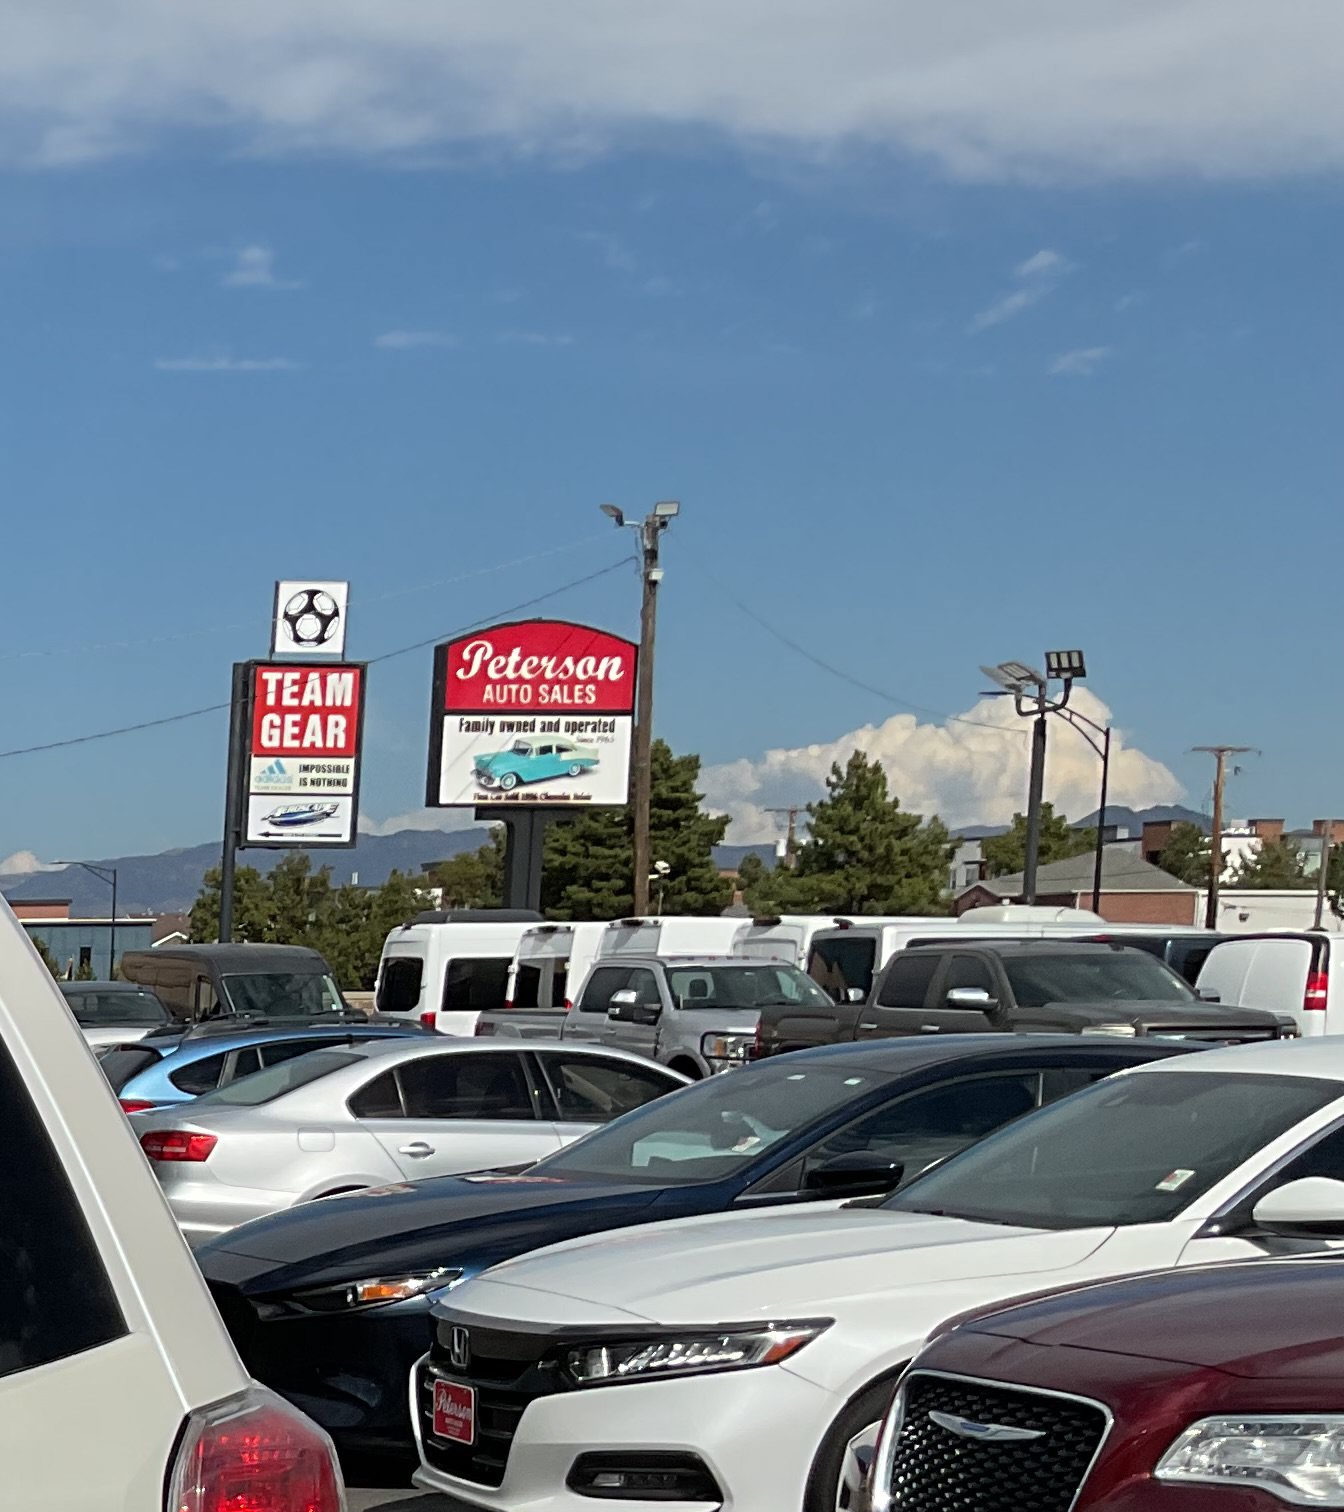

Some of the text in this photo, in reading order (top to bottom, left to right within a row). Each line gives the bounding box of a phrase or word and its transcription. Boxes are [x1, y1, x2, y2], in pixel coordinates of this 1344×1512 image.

[456, 640, 625, 681] Peterson
[261, 672, 354, 707] TEAM
[482, 683, 596, 704] AUTO SALES
[260, 712, 347, 749] GEAR
[459, 718, 616, 735] Family owned and operated
[298, 763, 350, 774] IMPOSSIBLE
[298, 777, 348, 788] IS NOTHING
